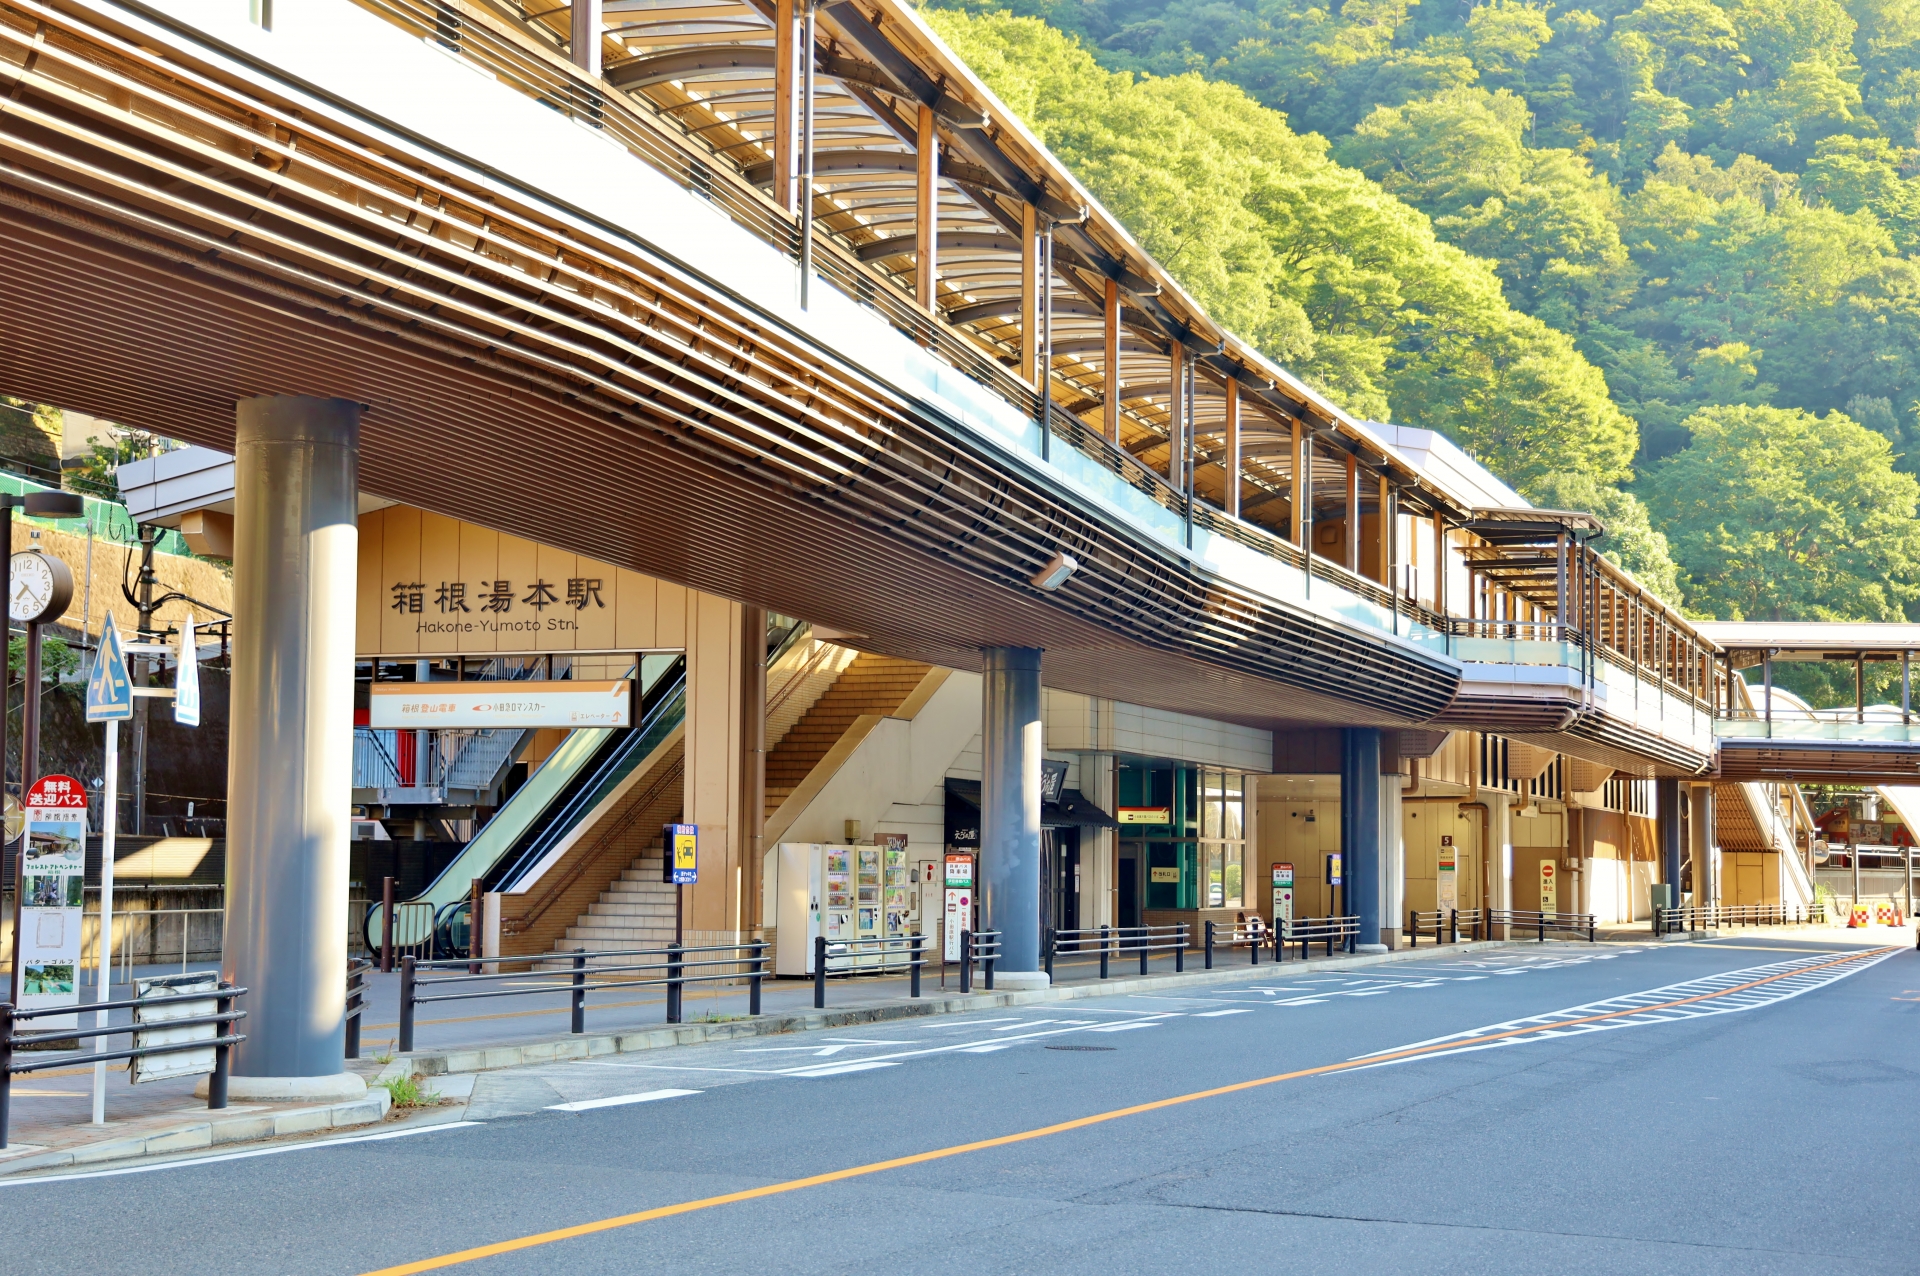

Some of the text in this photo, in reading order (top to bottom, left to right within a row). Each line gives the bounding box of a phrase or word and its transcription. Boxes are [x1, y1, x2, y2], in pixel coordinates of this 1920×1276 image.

[23, 560, 32, 569] 12
[41, 570, 48, 579] 2
[44, 581, 51, 591] 3
[40, 593, 47, 602] 4
[391, 578, 606, 615] 箱根湯本駅
[14, 602, 21, 611] 7
[22, 605, 30, 614] 6
[32, 602, 40, 611] 5
[416, 618, 579, 634] Hakone-Yumoto Stn.
[401, 703, 457, 713] 箱根登山電車
[43, 780, 71, 793] 無料
[29, 793, 84, 806] 送迎バス
[1444, 836, 1450, 845] 5
